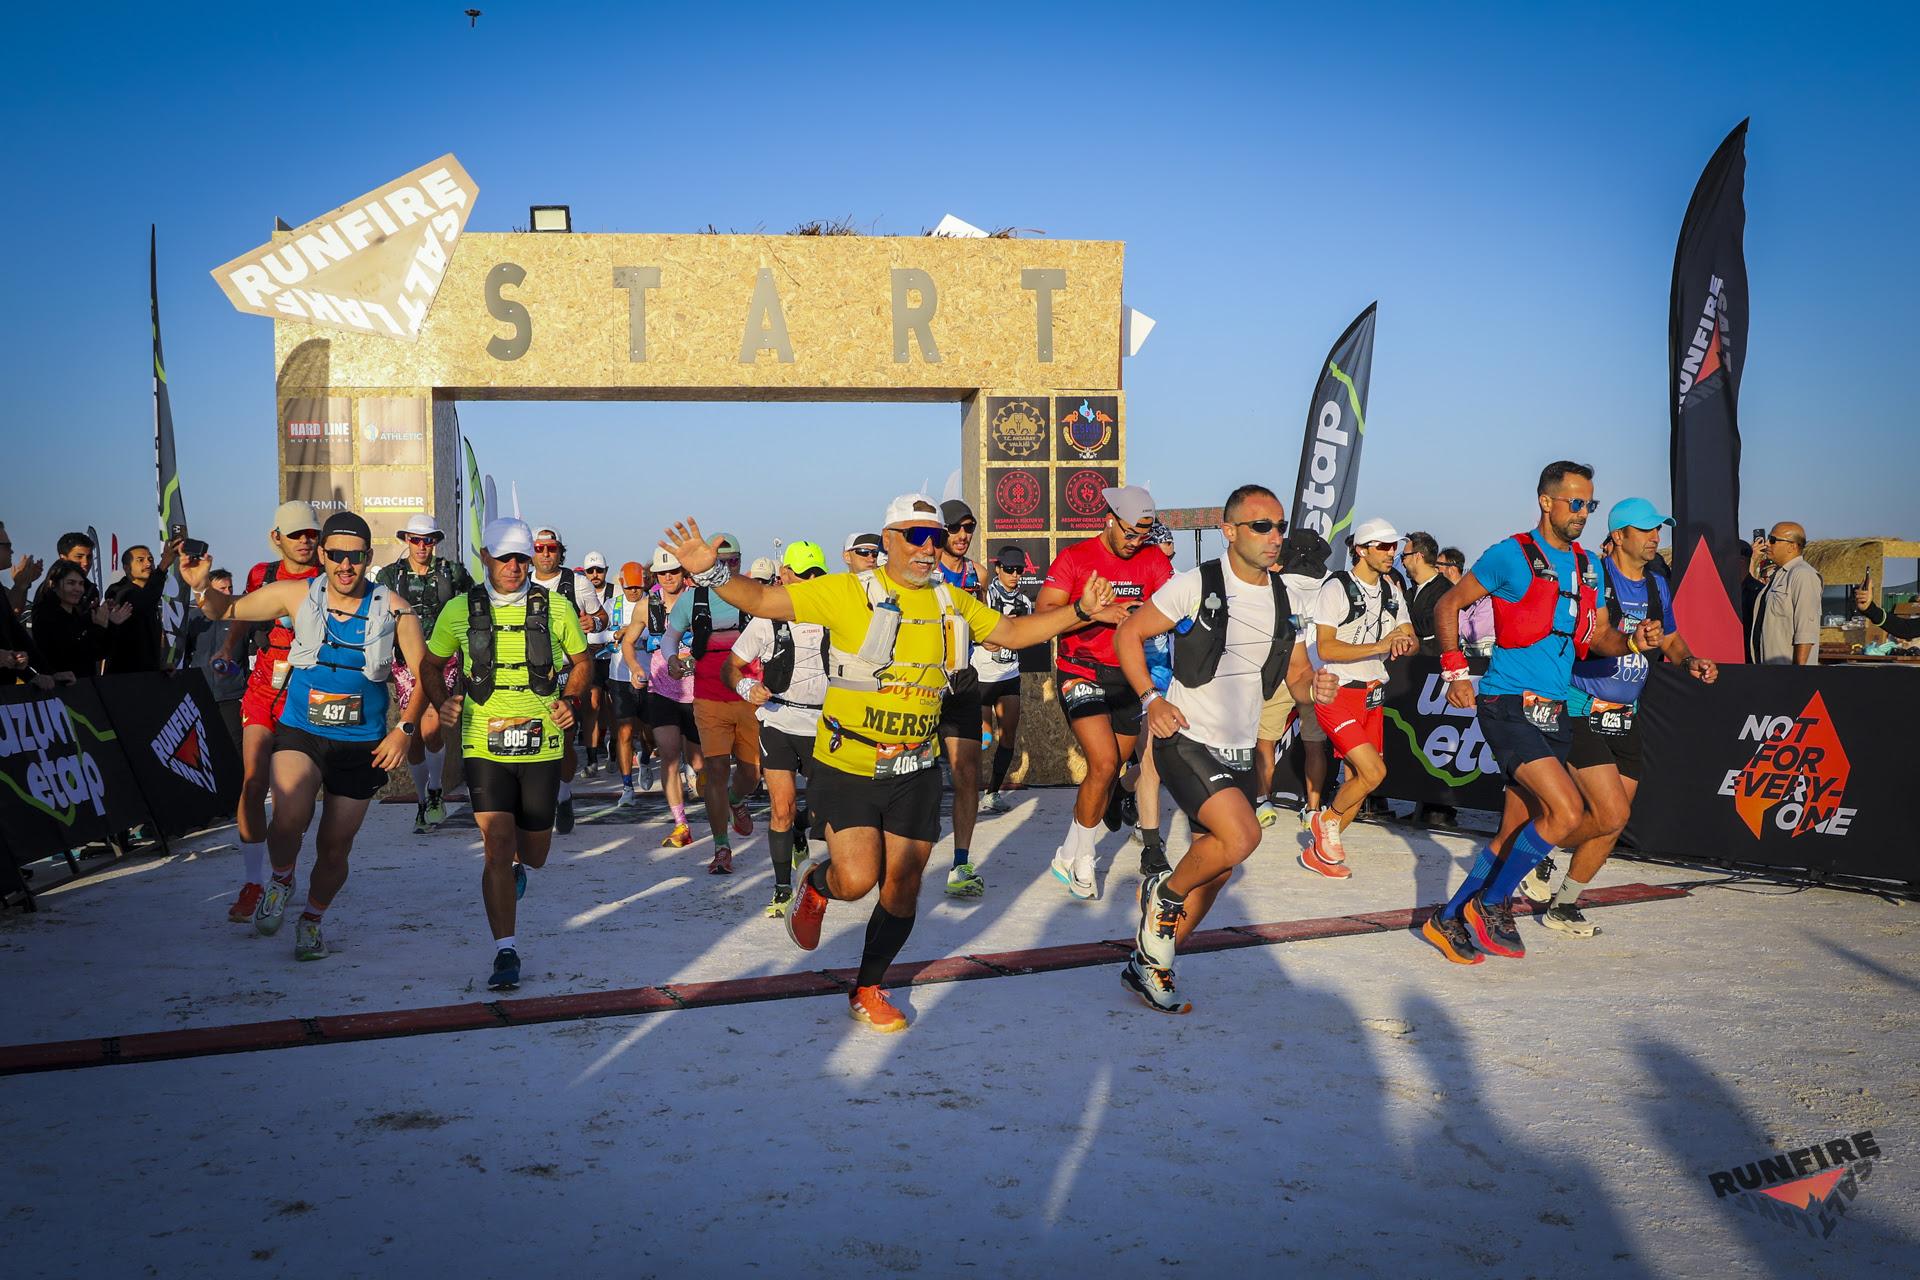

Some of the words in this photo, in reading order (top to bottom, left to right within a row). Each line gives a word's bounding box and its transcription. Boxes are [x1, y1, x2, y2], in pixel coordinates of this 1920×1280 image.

[229, 168, 467, 308] RUNFIRE
[397, 209, 460, 335] SALT
[275, 288, 406, 335] LAKE
[485, 262, 1067, 363] START
[291, 423, 321, 436] HARD
[324, 423, 349, 436] LINE
[1073, 422, 1102, 433] ESKİL
[1302, 401, 1348, 544] etap
[305, 500, 348, 510] RMIN
[364, 497, 424, 506] KÄRCHER
[1000, 648, 1012, 659] 824
[1616, 652, 1649, 669] TEAM
[1611, 664, 1647, 683] 2024
[322, 704, 346, 720] 437
[1601, 711, 1621, 728] 825
[150, 693, 202, 768] RUNFIRE
[503, 729, 527, 747] 805
[1738, 714, 1820, 743] NOT
[892, 755, 919, 775] 406
[1749, 743, 1826, 774] FOR
[27, 749, 106, 817] etap
[1775, 802, 1858, 836] ONE
